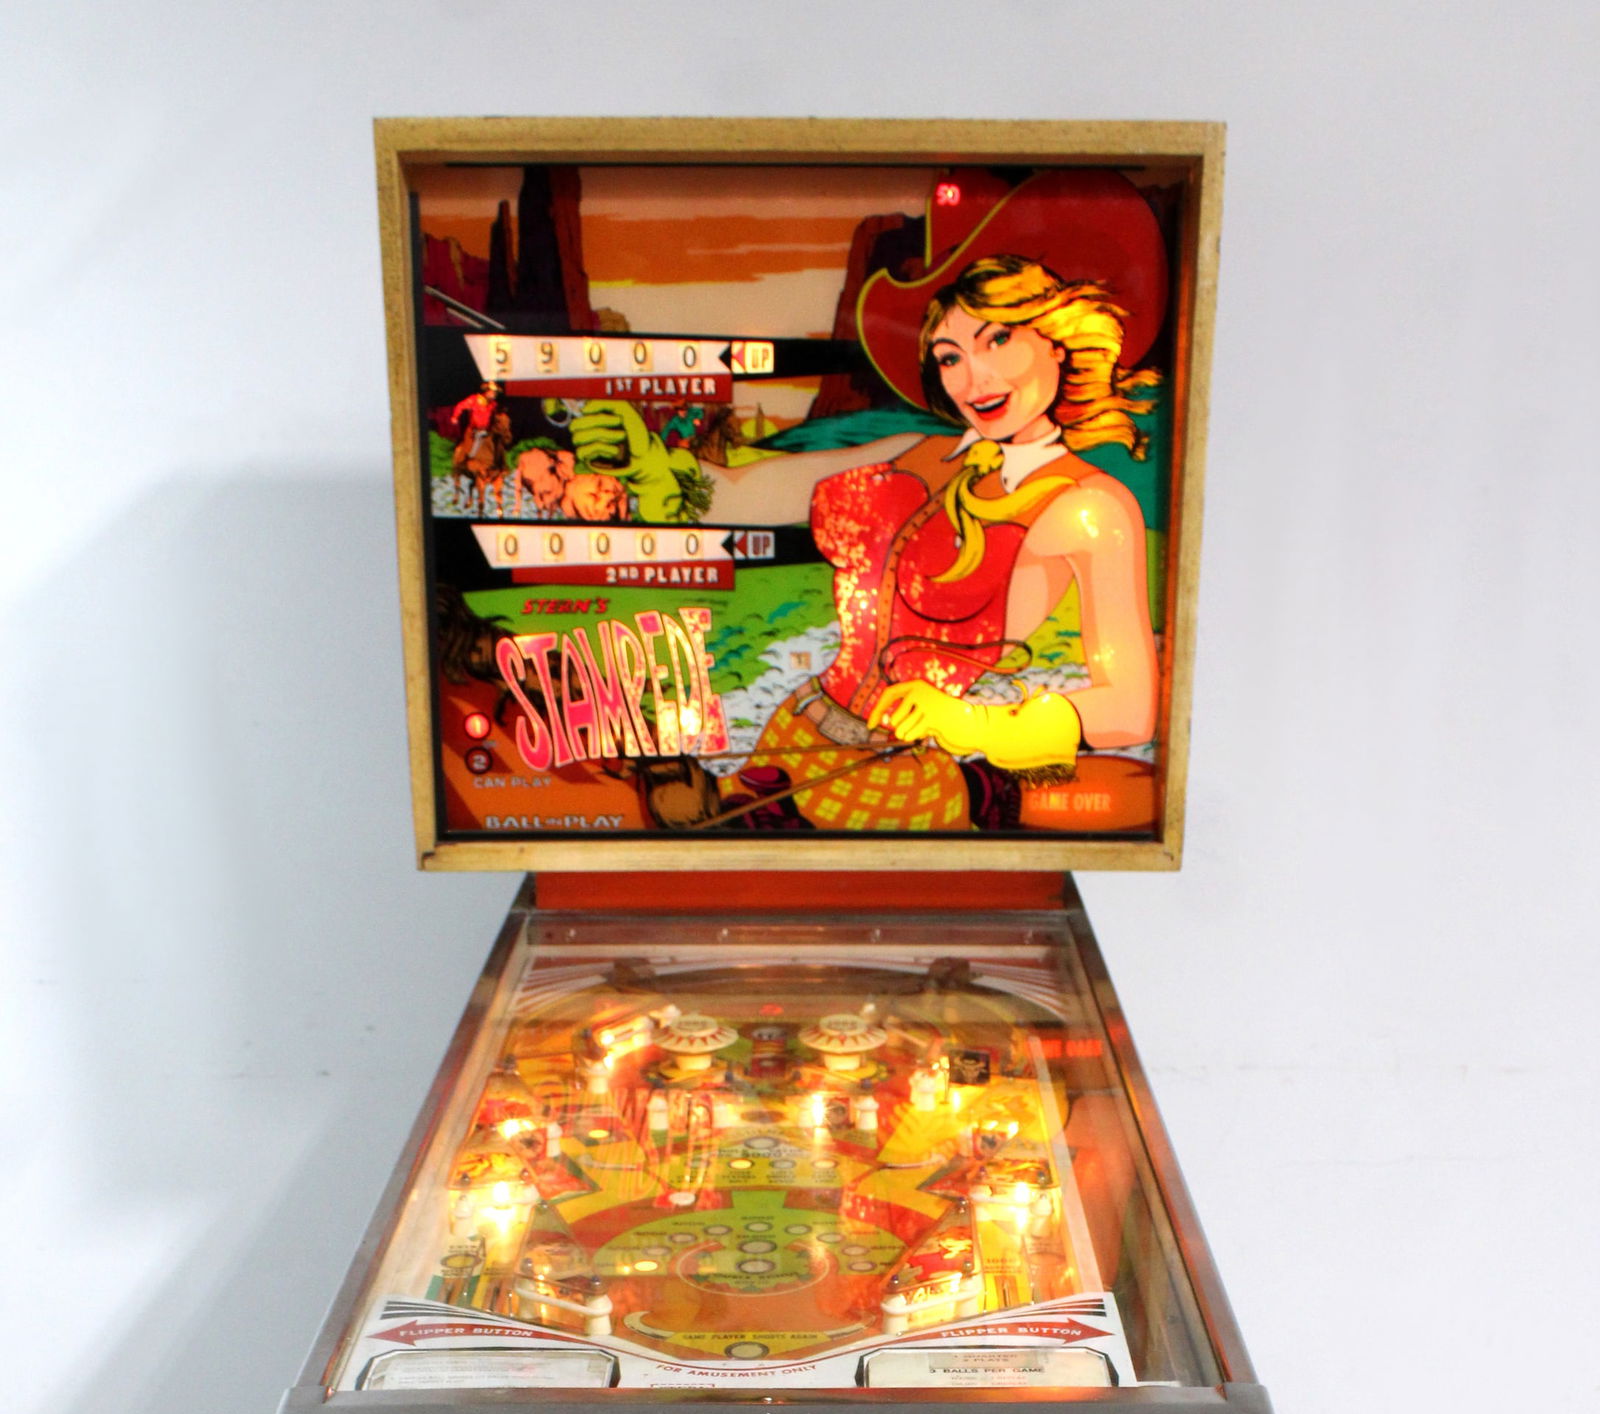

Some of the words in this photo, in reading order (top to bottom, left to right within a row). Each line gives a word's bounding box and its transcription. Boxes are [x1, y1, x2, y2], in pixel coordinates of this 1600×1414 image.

[640, 377, 716, 396] PLAYER
[751, 535, 771, 556] UP
[644, 566, 718, 584] PLAYER
[520, 597, 611, 615] STERN'S
[495, 606, 731, 772] STAMPEDE
[473, 754, 487, 771] 2
[473, 775, 506, 789] CAN
[510, 775, 552, 788] PLAY
[1029, 792, 1069, 811] GAME
[1073, 792, 1111, 812] OVER
[485, 815, 543, 829] BALL
[563, 815, 623, 829] PLAY
[400, 1326, 466, 1337] FLIPPER
[472, 1327, 533, 1338] BUTTON
[940, 1326, 1009, 1338] FLIPPER
[1018, 1326, 1082, 1337] BUTTON
[655, 1364, 683, 1374] FOR
[688, 1369, 777, 1378] AMUSEMENT
[781, 1364, 818, 1376] ONLY
